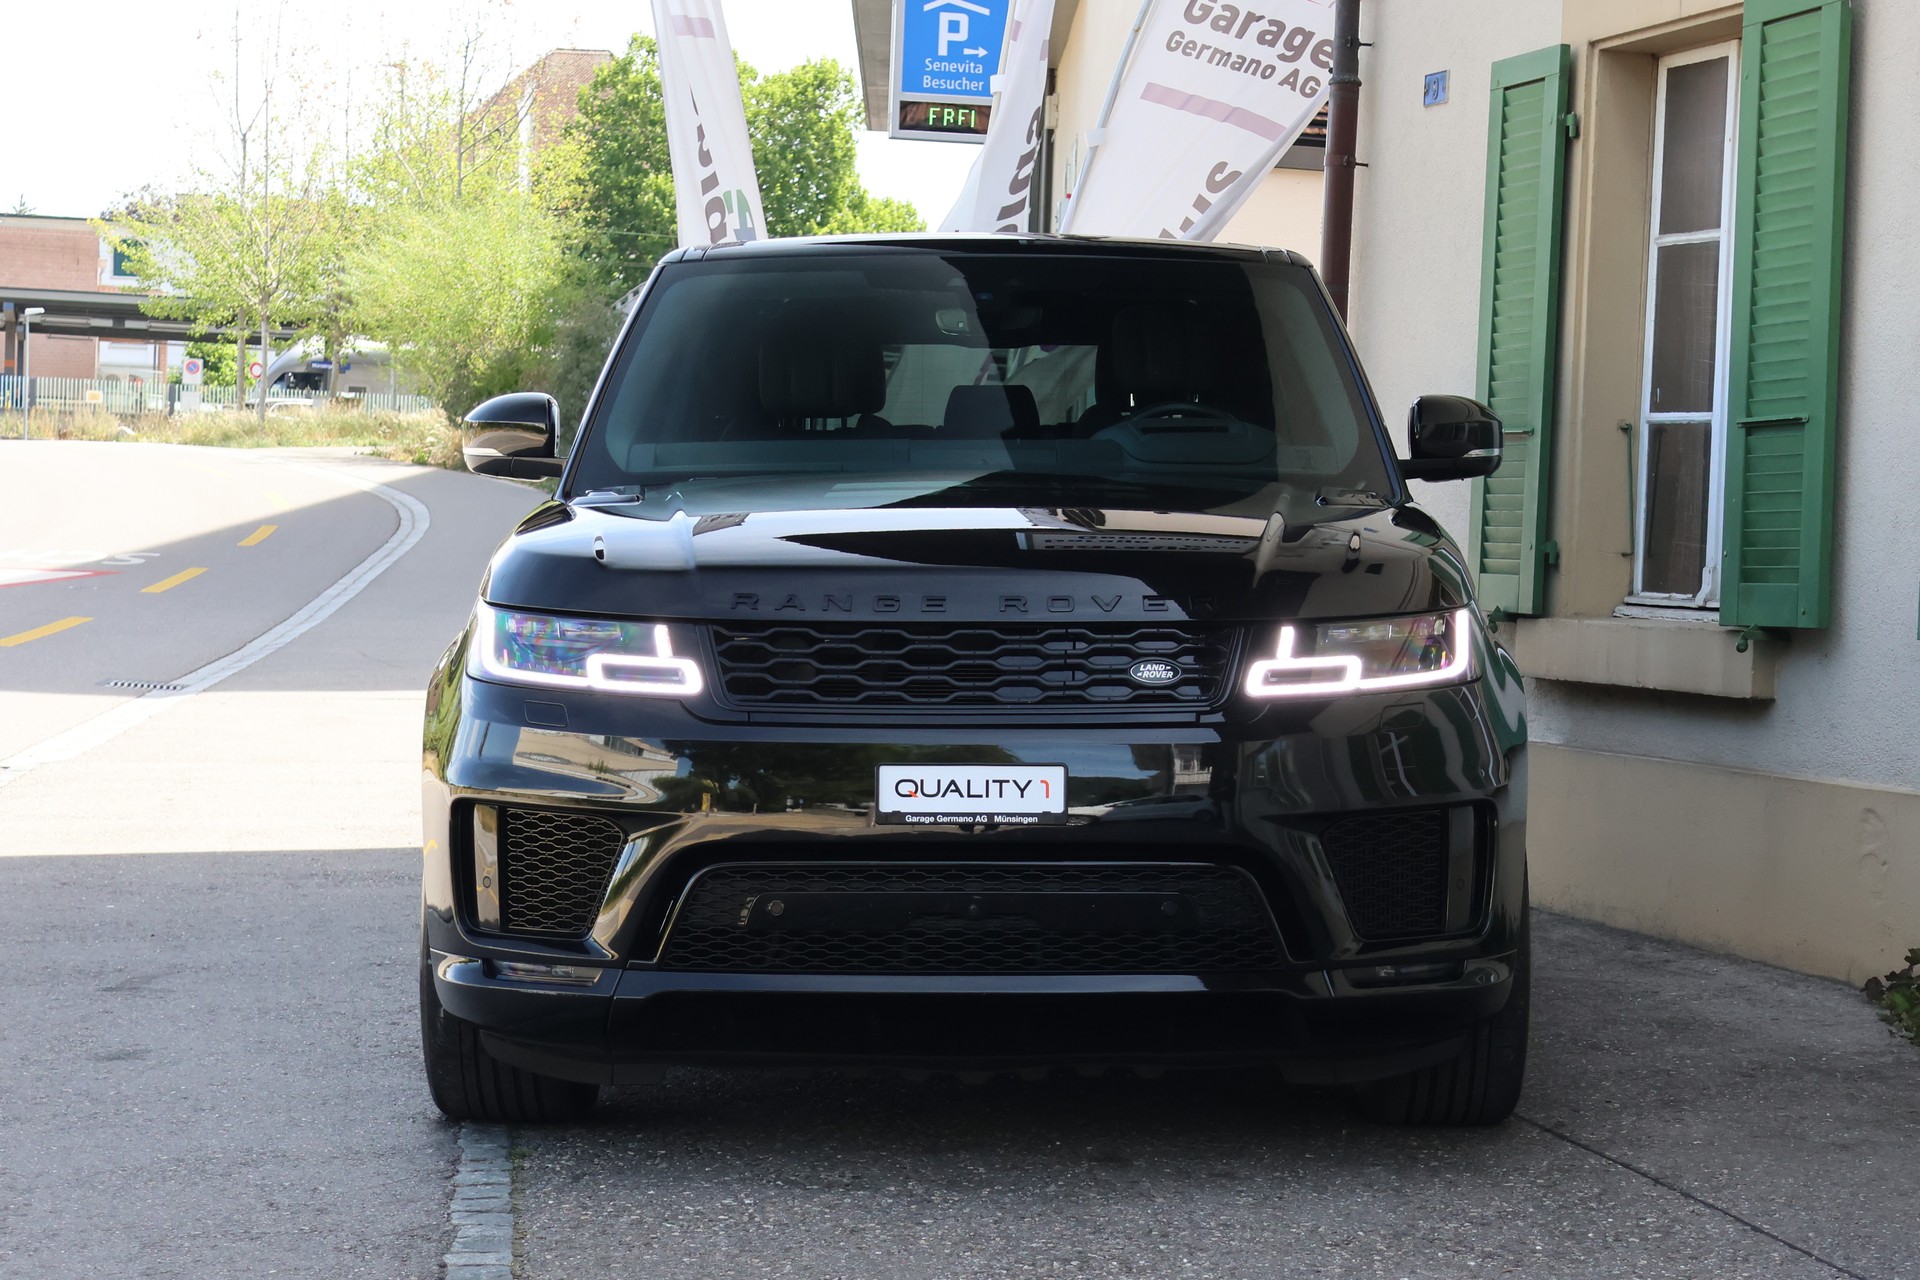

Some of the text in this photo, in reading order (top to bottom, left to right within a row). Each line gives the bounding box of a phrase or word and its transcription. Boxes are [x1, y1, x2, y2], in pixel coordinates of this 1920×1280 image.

[938, 11, 969, 56] P
[1183, 0, 1335, 69] Garage
[925, 58, 983, 74] Senevita
[1165, 30, 1321, 99] Germano AG
[923, 75, 985, 91] Besucher
[730, 592, 947, 612] RANGE
[895, 778, 1050, 799] QUALITY 1
[905, 814, 1038, 824] Garage Germano AG Münsingen
